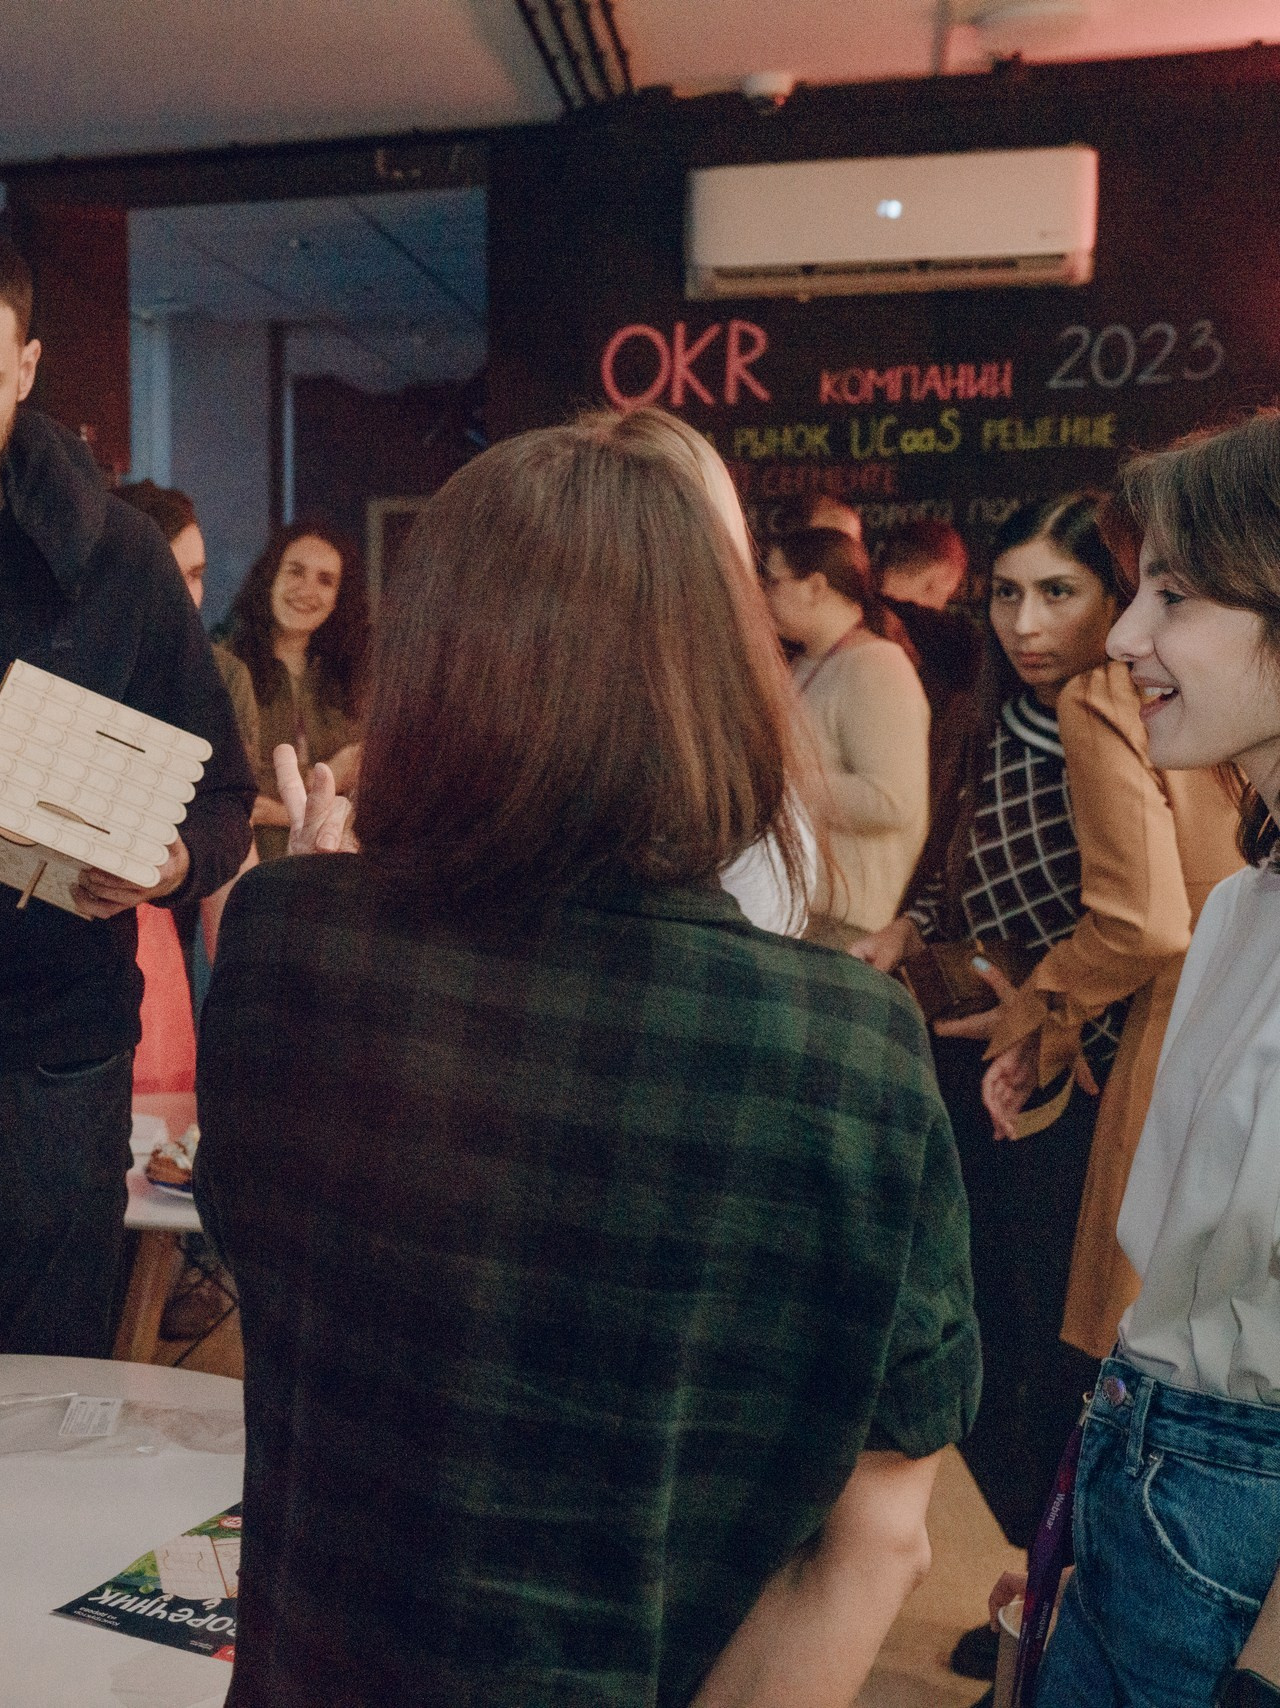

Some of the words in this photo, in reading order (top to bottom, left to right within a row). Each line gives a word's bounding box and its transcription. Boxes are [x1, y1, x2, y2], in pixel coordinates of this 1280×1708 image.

[821, 359, 1013, 402] КОМПАНИИ
[1047, 319, 1222, 390] 2023
[733, 422, 831, 460] РЫНОК
[849, 408, 962, 459] UCaaS
[1046, 1493, 1066, 1531] Webinar
